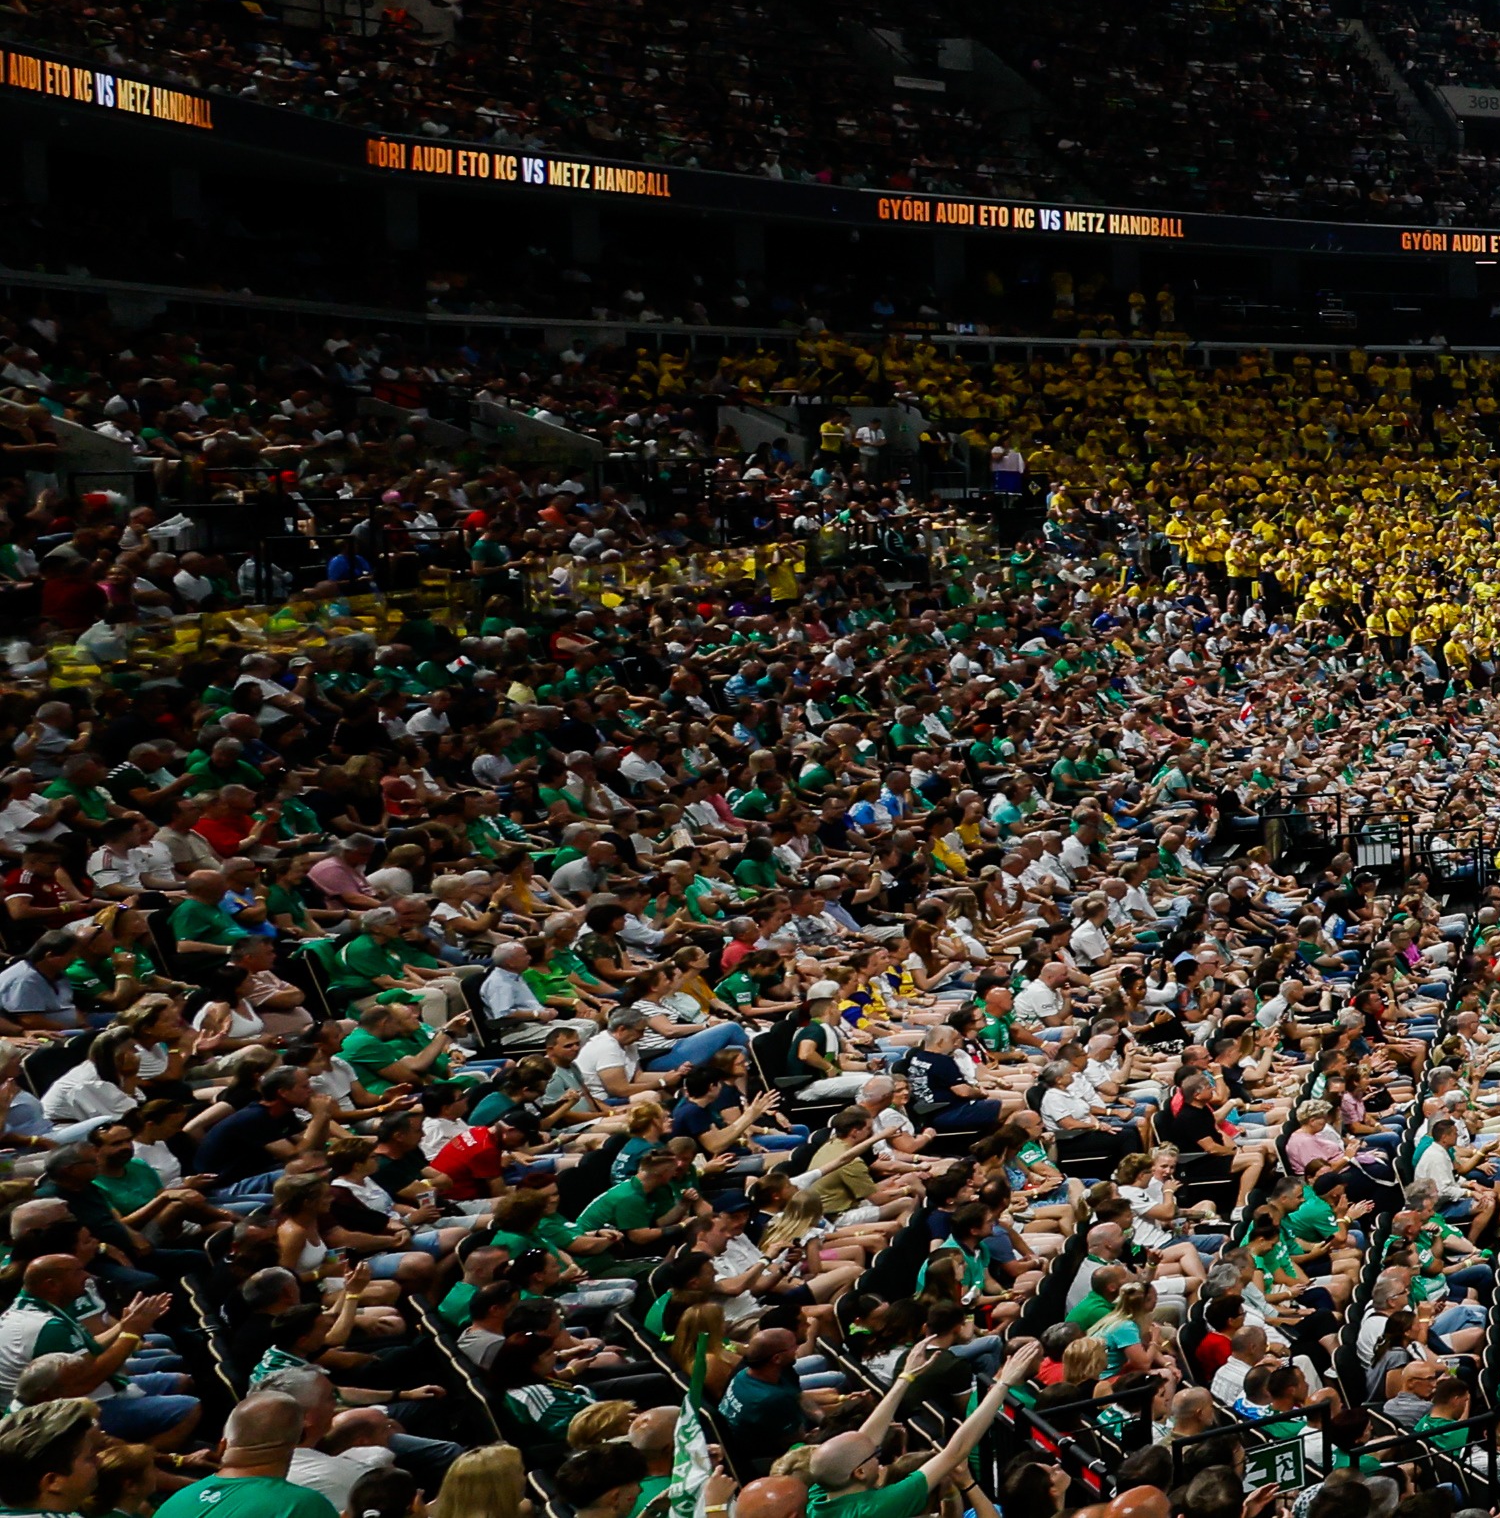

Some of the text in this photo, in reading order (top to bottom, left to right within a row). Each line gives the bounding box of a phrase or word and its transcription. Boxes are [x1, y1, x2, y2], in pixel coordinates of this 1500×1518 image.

[9, 53, 41, 91] AUDI
[45, 61, 70, 97] ETO
[74, 68, 92, 102] KC
[96, 73, 114, 107] VS
[117, 78, 150, 115] METZ
[153, 87, 212, 128] HANDBALL
[1468, 95, 1499, 110] 308
[412, 146, 670, 196] AUDI ETO KC VS METZ HANDBALL
[936, 203, 974, 225] AUDI
[979, 205, 1008, 227] ETO
[1014, 208, 1034, 228] KC
[1040, 209, 1060, 230] VS
[1065, 211, 1104, 233] METZ
[1109, 214, 1184, 237] HANDBALL
[1452, 235, 1486, 252] AUDI
